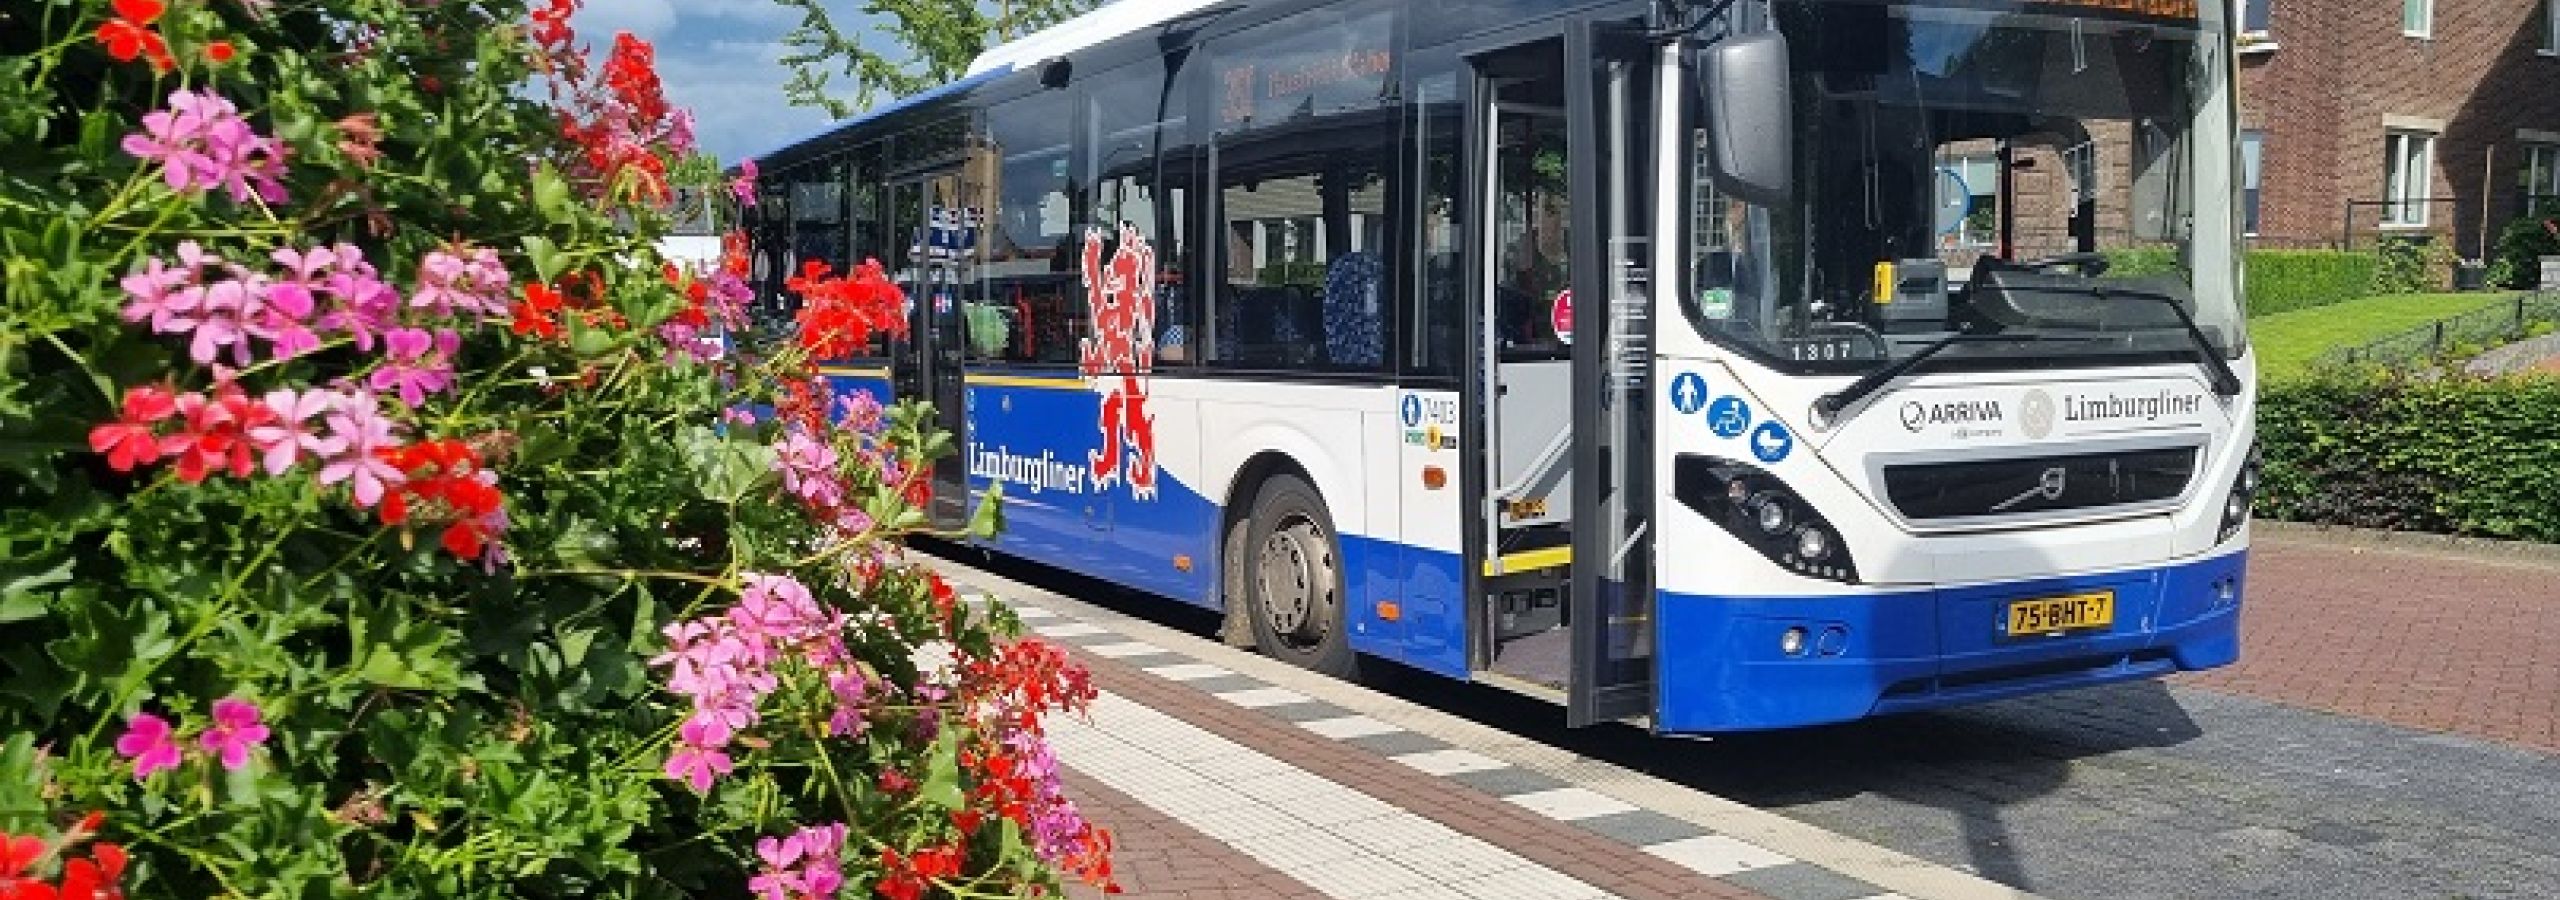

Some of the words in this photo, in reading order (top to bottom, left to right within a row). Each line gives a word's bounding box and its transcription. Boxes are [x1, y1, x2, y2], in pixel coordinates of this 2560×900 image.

[1791, 341, 1850, 361] 1307
[1928, 400, 2003, 425] ARRIVA
[2064, 389, 2202, 421] Limburgliner
[969, 441, 1086, 493] Limburgliner
[2015, 597, 2108, 631] 75-BHT-7
